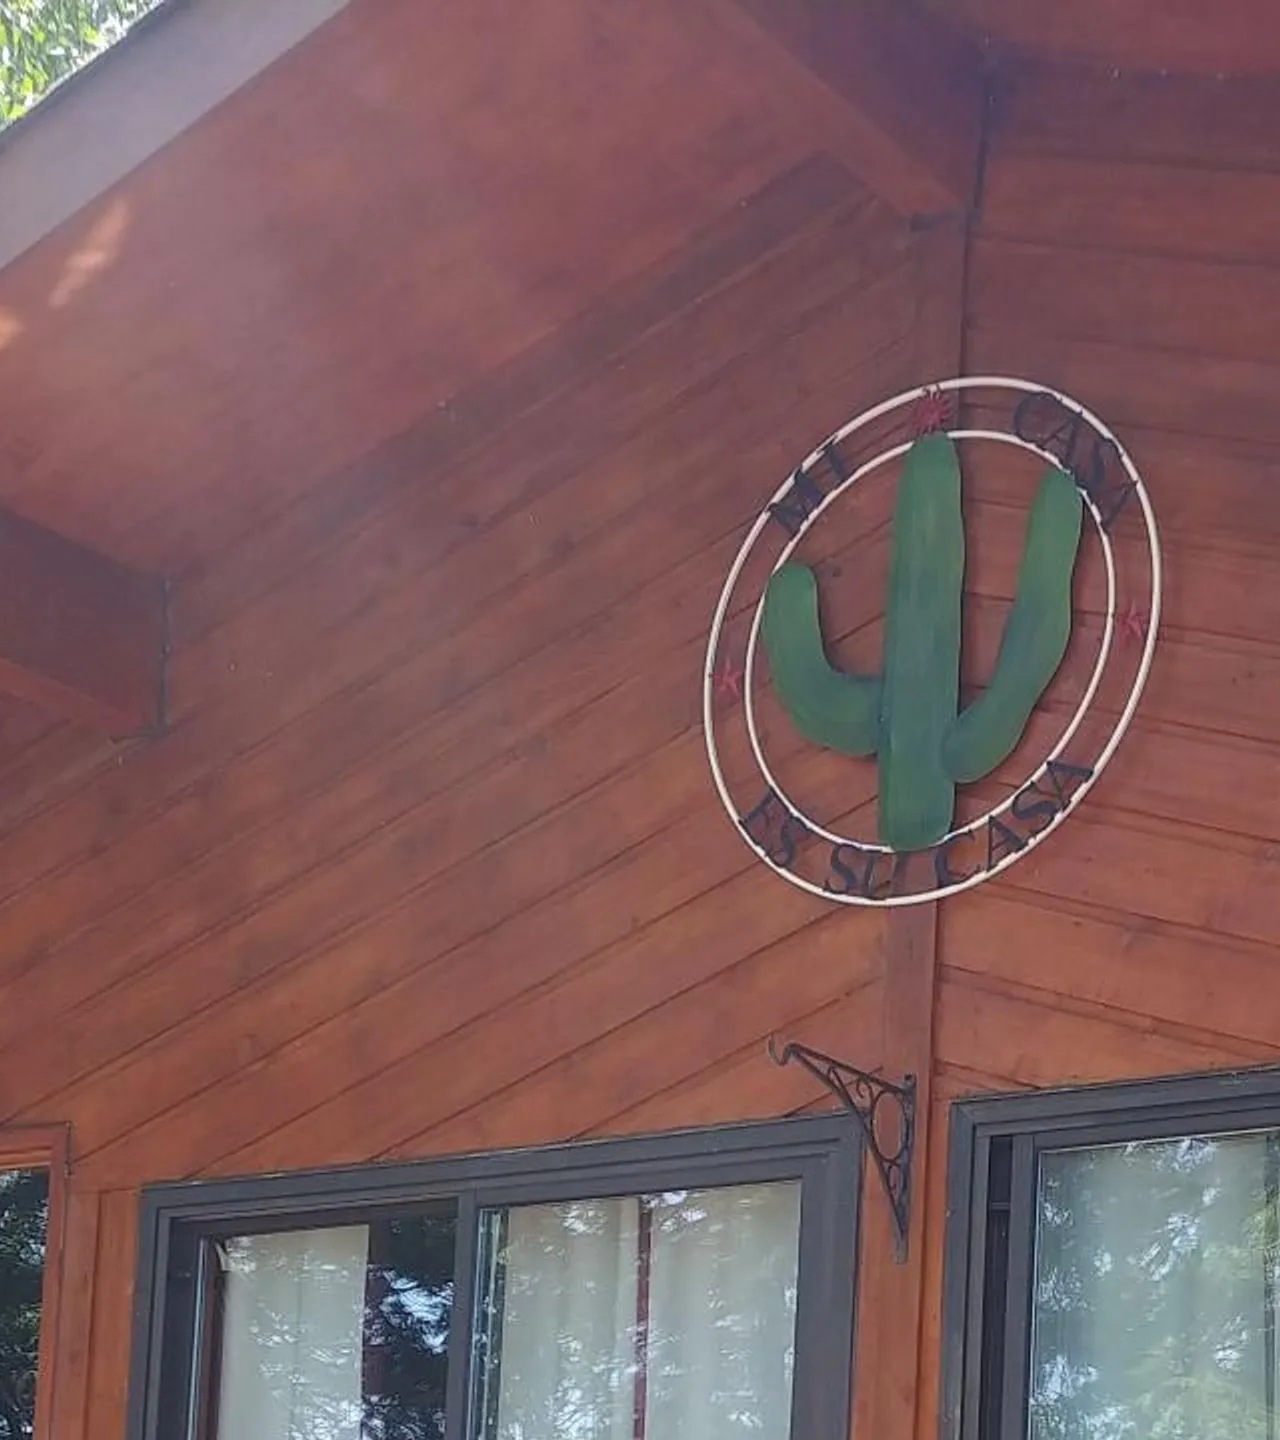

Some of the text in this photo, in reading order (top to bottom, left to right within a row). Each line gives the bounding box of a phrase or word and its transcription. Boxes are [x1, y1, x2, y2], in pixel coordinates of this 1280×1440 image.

[1013, 391, 1138, 530] CASA
[738, 785, 810, 868] ES
[935, 760, 1094, 888] CASA
